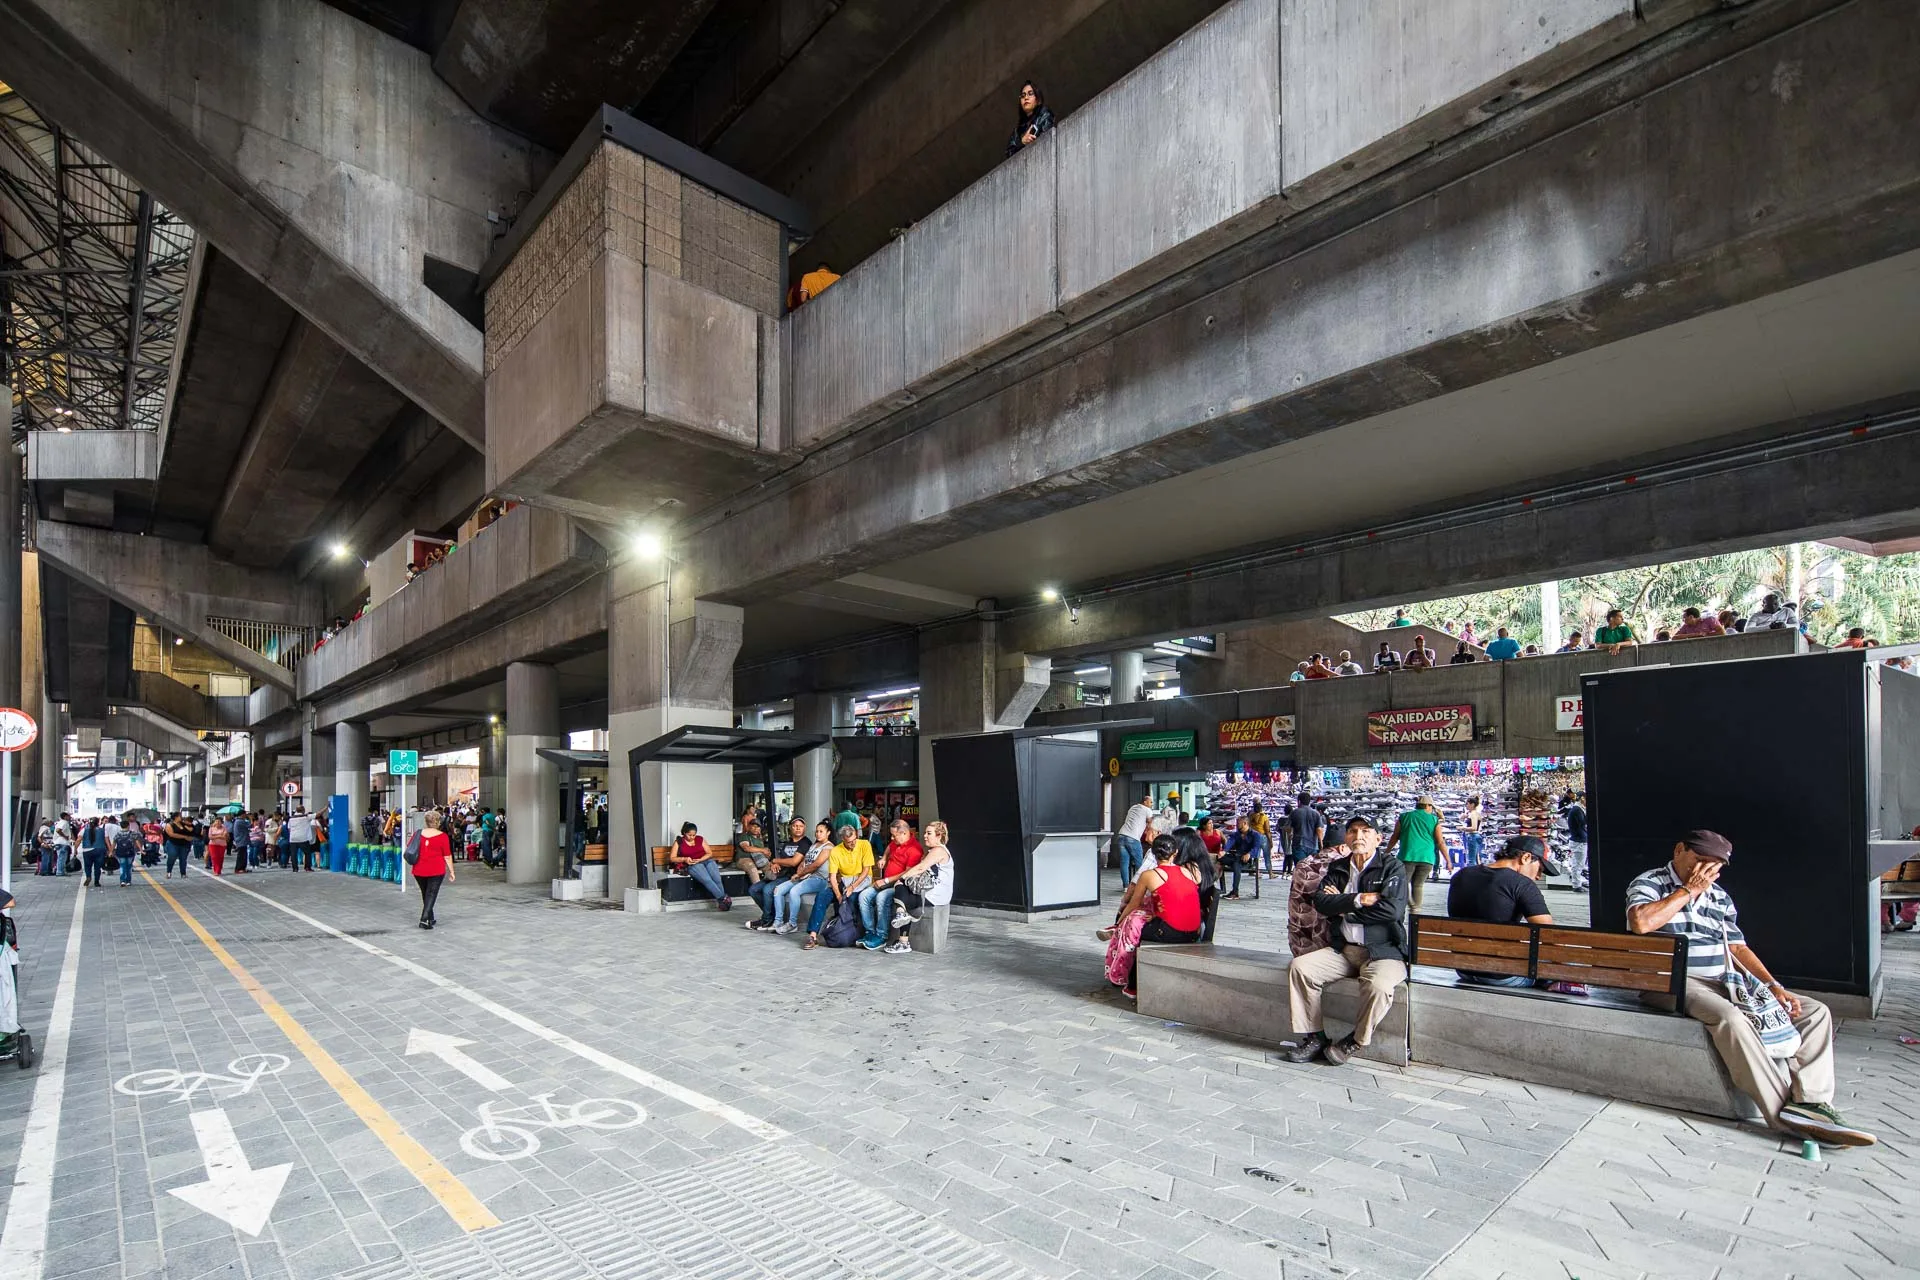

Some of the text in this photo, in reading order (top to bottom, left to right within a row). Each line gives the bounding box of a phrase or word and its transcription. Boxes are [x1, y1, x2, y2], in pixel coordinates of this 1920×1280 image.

[1380, 709, 1459, 725] VARIEDADES
[1221, 718, 1271, 733] CALZADO
[1230, 730, 1262, 742] H&E
[1137, 740, 1190, 750] SERVIENTREGA
[401, 752, 408, 760] P
